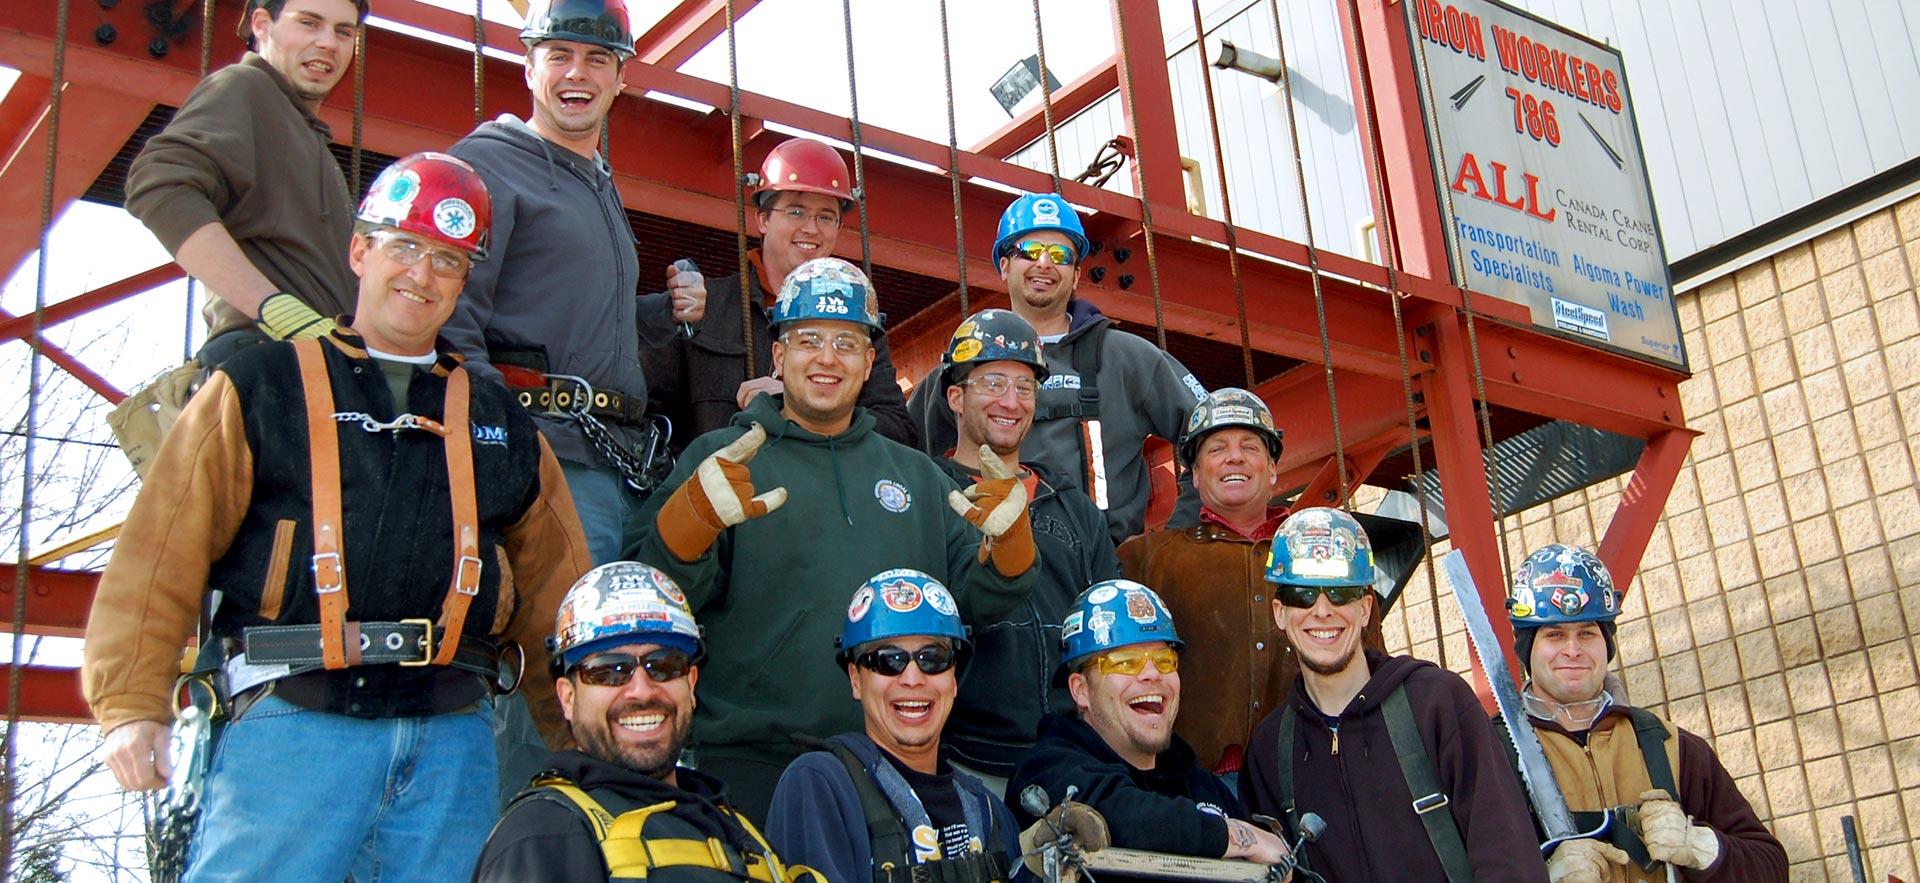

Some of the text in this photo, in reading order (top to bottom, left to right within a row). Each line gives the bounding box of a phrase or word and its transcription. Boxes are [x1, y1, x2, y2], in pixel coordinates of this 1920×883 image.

[1414, 0, 1623, 114] IRON WORKERS
[1505, 87, 1561, 147] 786
[1451, 152, 1556, 223] ALL
[1556, 189, 1655, 237] CANADA CRANE
[1565, 211, 1613, 242] RENTAL
[1470, 250, 1554, 294] Specialists
[1573, 254, 1665, 300] Algoma Power
[1606, 291, 1645, 321] Wash
